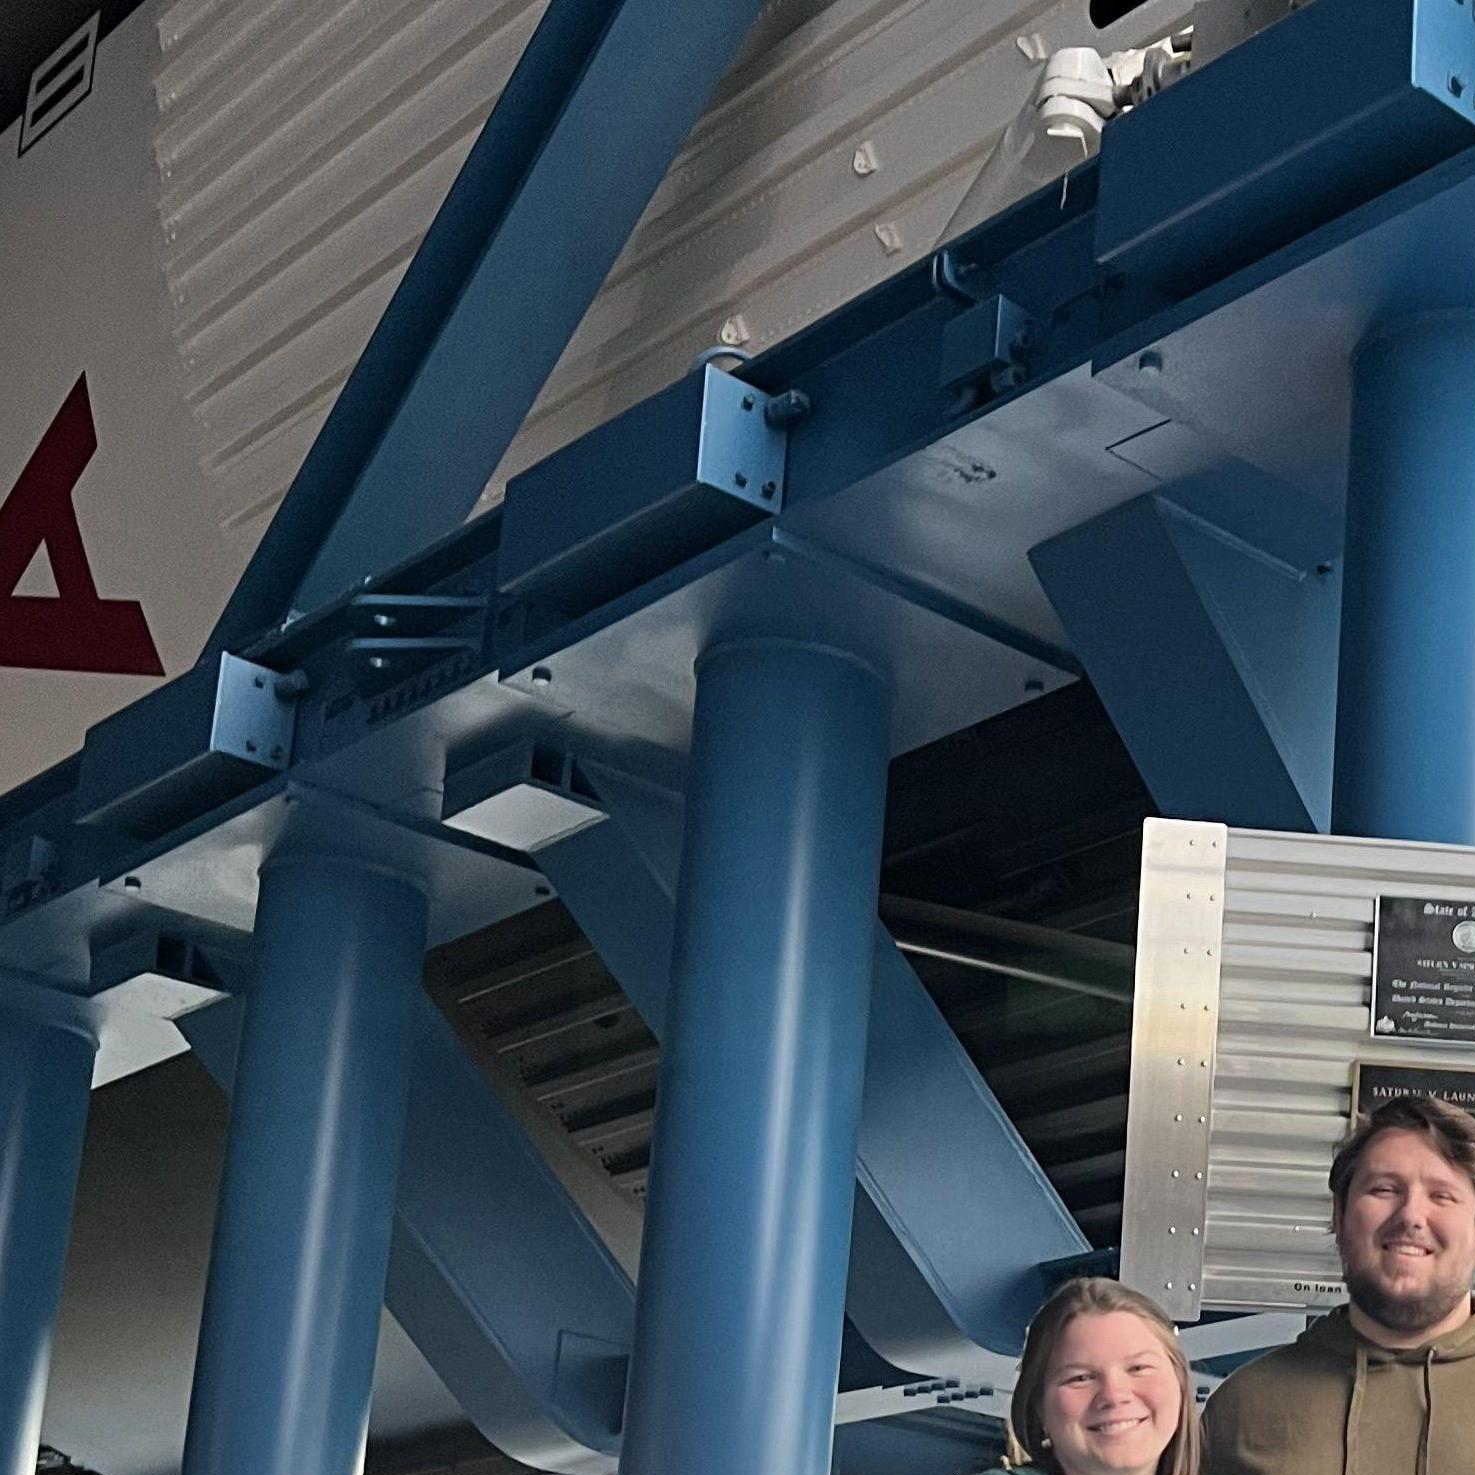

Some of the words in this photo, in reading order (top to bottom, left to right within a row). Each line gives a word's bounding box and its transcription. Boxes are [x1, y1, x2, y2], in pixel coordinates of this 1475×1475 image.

[1423, 902, 1454, 917] State
[1457, 906, 1468, 917] of
[1428, 1090, 1437, 1099] V
[1294, 1283, 1310, 1292] On
[1315, 1283, 1342, 1294] loan
